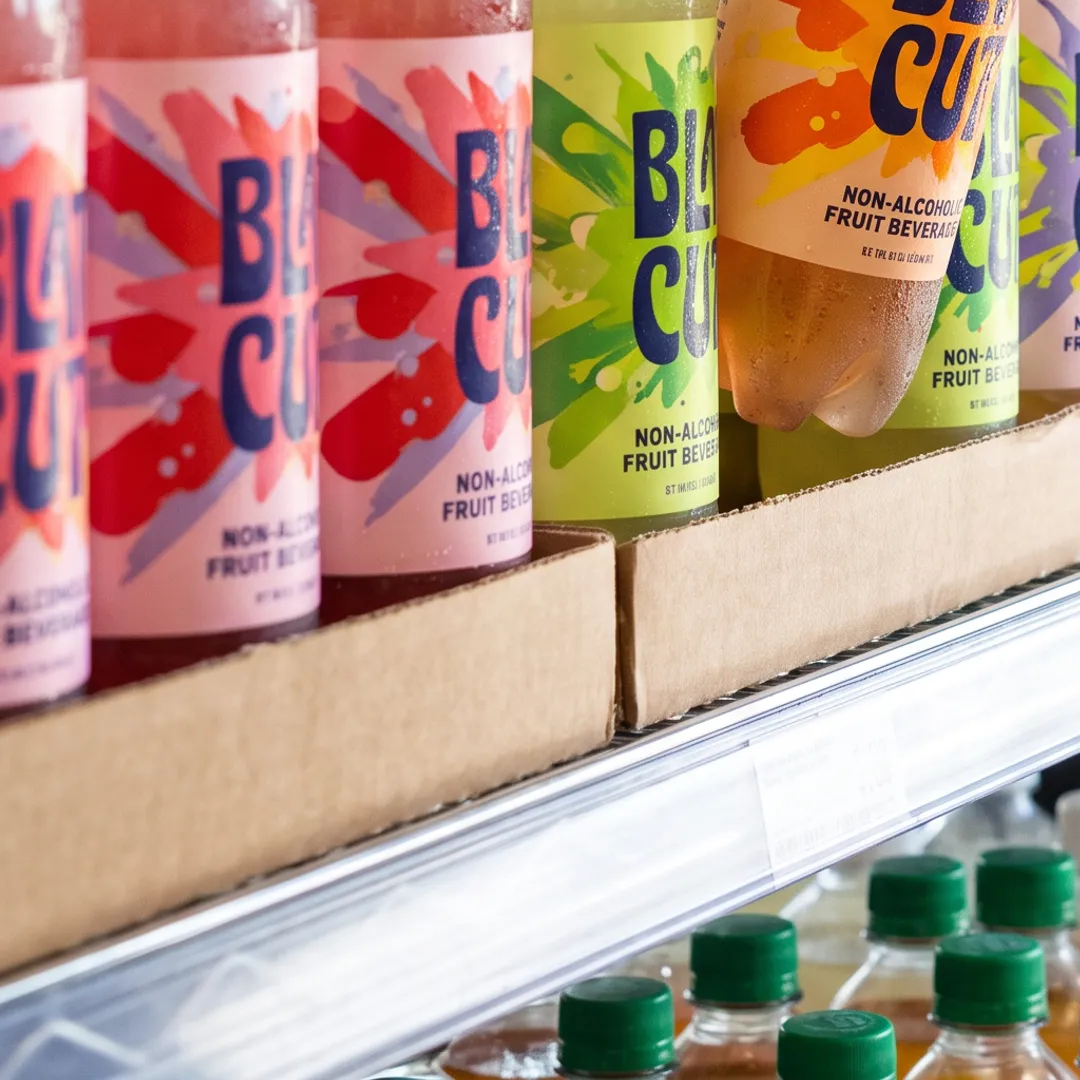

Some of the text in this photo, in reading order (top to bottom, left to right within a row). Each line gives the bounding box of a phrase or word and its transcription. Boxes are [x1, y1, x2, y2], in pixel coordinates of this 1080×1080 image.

[842, 185, 962, 217] NON-ALCOHOLIC
[824, 205, 885, 233] FRUIT
[932, 369, 980, 389] FRUIT
[623, 449, 677, 473] FRUIT
[443, 495, 495, 522] FRUIT
